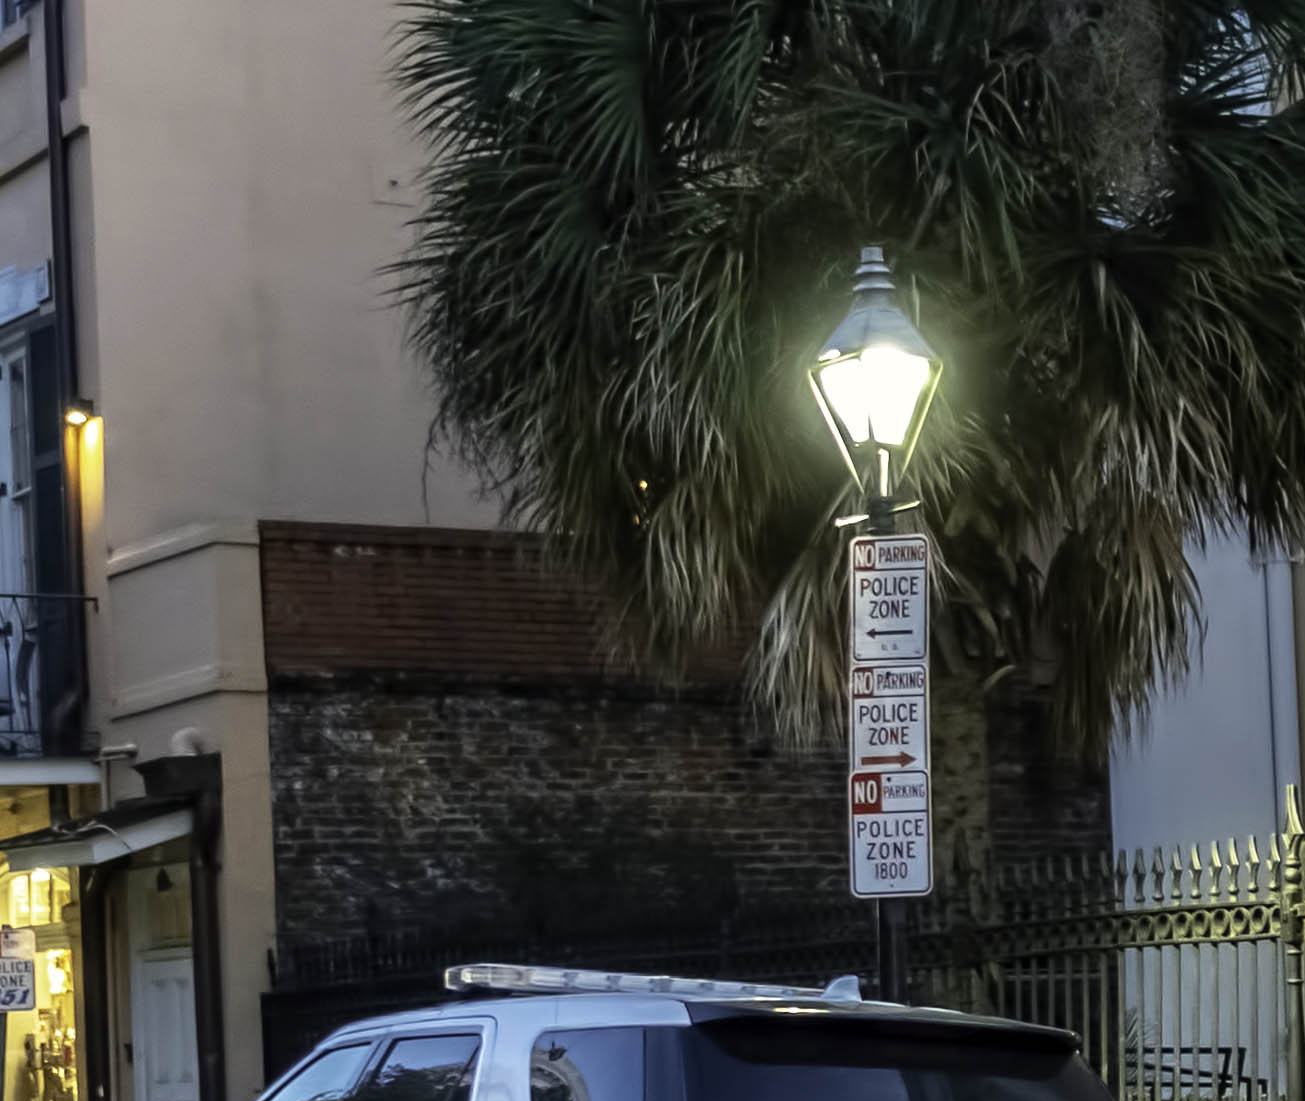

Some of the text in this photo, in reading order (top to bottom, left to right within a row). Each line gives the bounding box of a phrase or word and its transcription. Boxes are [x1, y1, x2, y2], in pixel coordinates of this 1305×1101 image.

[855, 543, 925, 568] NO PARKING
[860, 576, 919, 597] POLICE
[869, 600, 911, 619] ZONE
[854, 671, 925, 695] NO PARKING
[859, 703, 918, 724] POLICE
[868, 726, 910, 746] ZONE
[854, 780, 925, 804] NO PARKING
[857, 819, 924, 839] POLICE
[866, 841, 916, 860] ZONE
[875, 862, 908, 880] 1800
[0, 960, 33, 973] LICE
[0, 987, 30, 1006] 51
